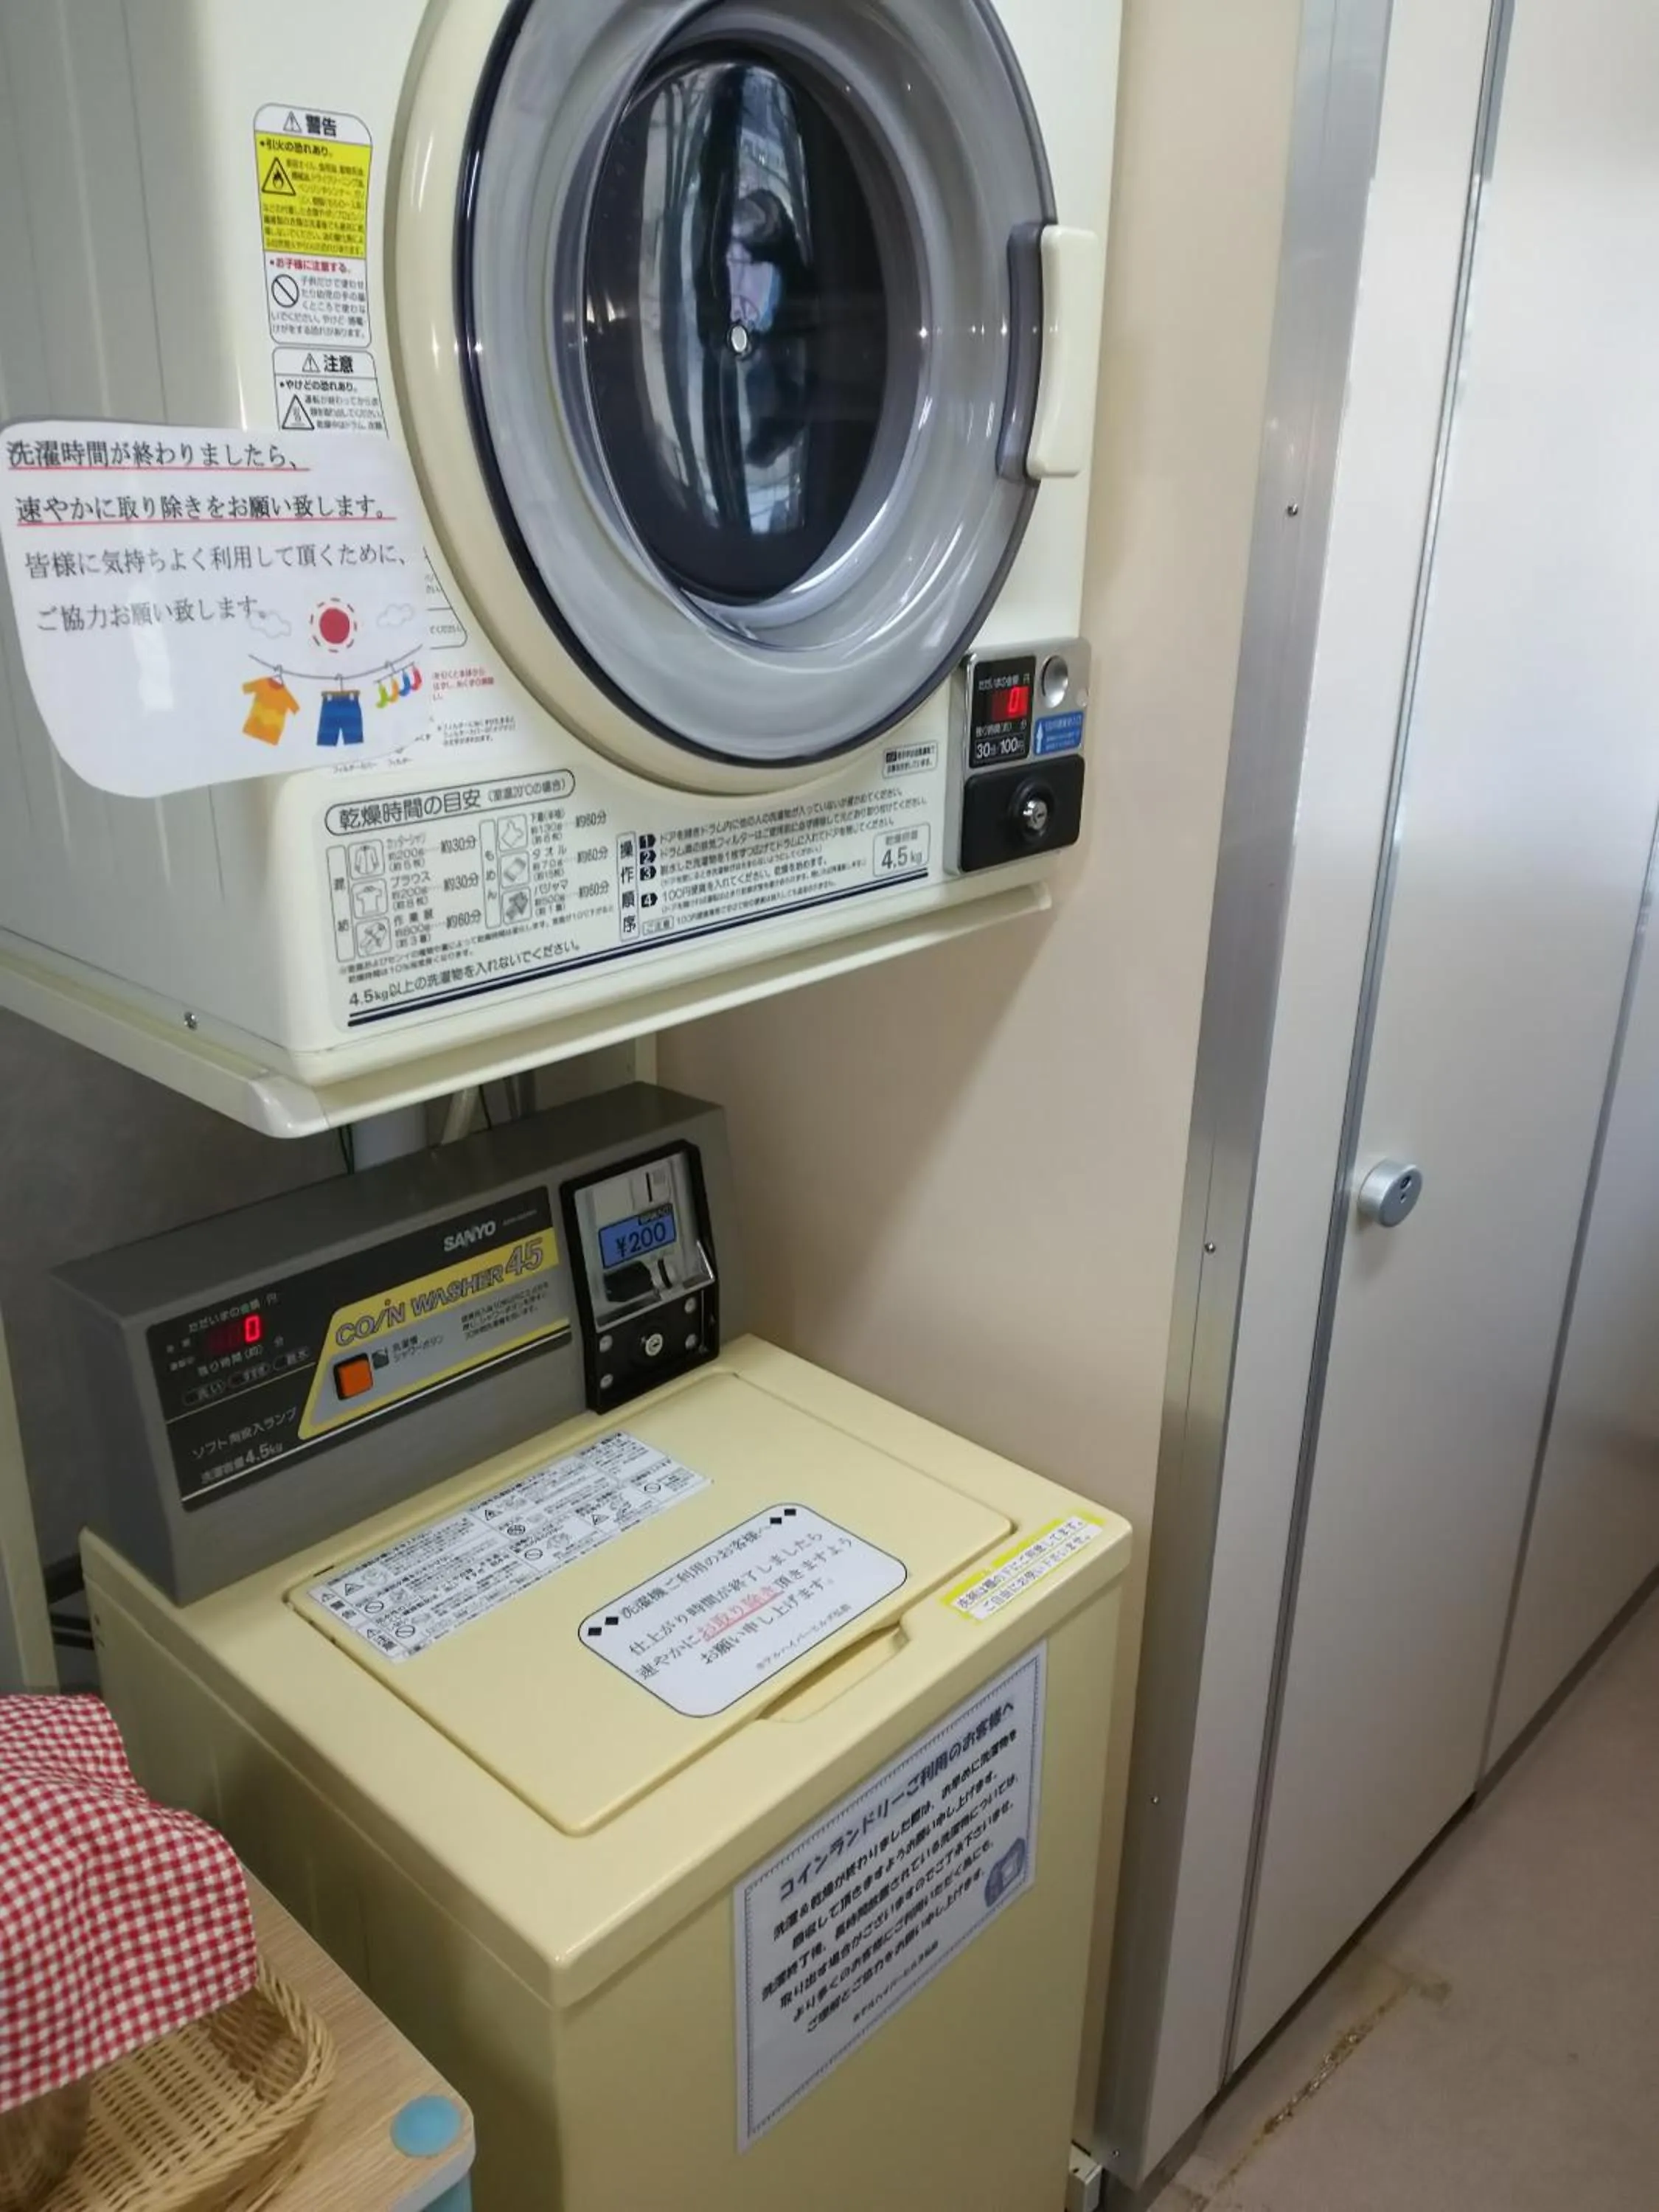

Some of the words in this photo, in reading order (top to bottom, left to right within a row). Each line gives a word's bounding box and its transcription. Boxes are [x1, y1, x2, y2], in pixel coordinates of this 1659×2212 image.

[305, 115, 337, 137] 警告
[324, 354, 354, 373] 注意
[7, 439, 301, 469] 洗濯時間が終わりましたら、
[15, 494, 386, 524] 速やかに取り除きをお願い致します。
[25, 543, 408, 580] 皆様に気持ちよく利用して頂くために、
[36, 595, 270, 632] ご協力お願い致します。
[1009, 686, 1020, 717] 0
[338, 788, 482, 830] 乾燥時間の目安
[440, 836, 477, 854] 約30分
[390, 871, 431, 888] ブラウス
[443, 873, 479, 892] 約30分
[620, 840, 636, 933] 操作順序
[348, 939, 580, 1006] 4.5kg以上の洗濯物を入れないでください。
[443, 1221, 497, 1252] SANYO
[616, 1222, 667, 1259] ¥200
[411, 1264, 504, 1317] WASHER
[505, 1237, 544, 1276] 45
[244, 1314, 262, 1343] 0
[619, 1525, 772, 1620] 洗濯機ご利用のお客様へ
[629, 1531, 824, 1656] 仕上がり時間が終了しましたら
[635, 1537, 853, 1680] 速やかにお取り除き頂きますよう
[698, 1576, 835, 1666] お願い申し上げます。
[779, 1701, 1016, 1901] コインランドリーご利用のお客様へ
[791, 1770, 998, 1950] 回収して頂きますようお願い申し上げます。
[779, 1801, 1013, 2009] 取り出す場合がございますのでご了承下さいませ。
[806, 1866, 986, 2034] ご理解とご協力をお願い申し上げます。
